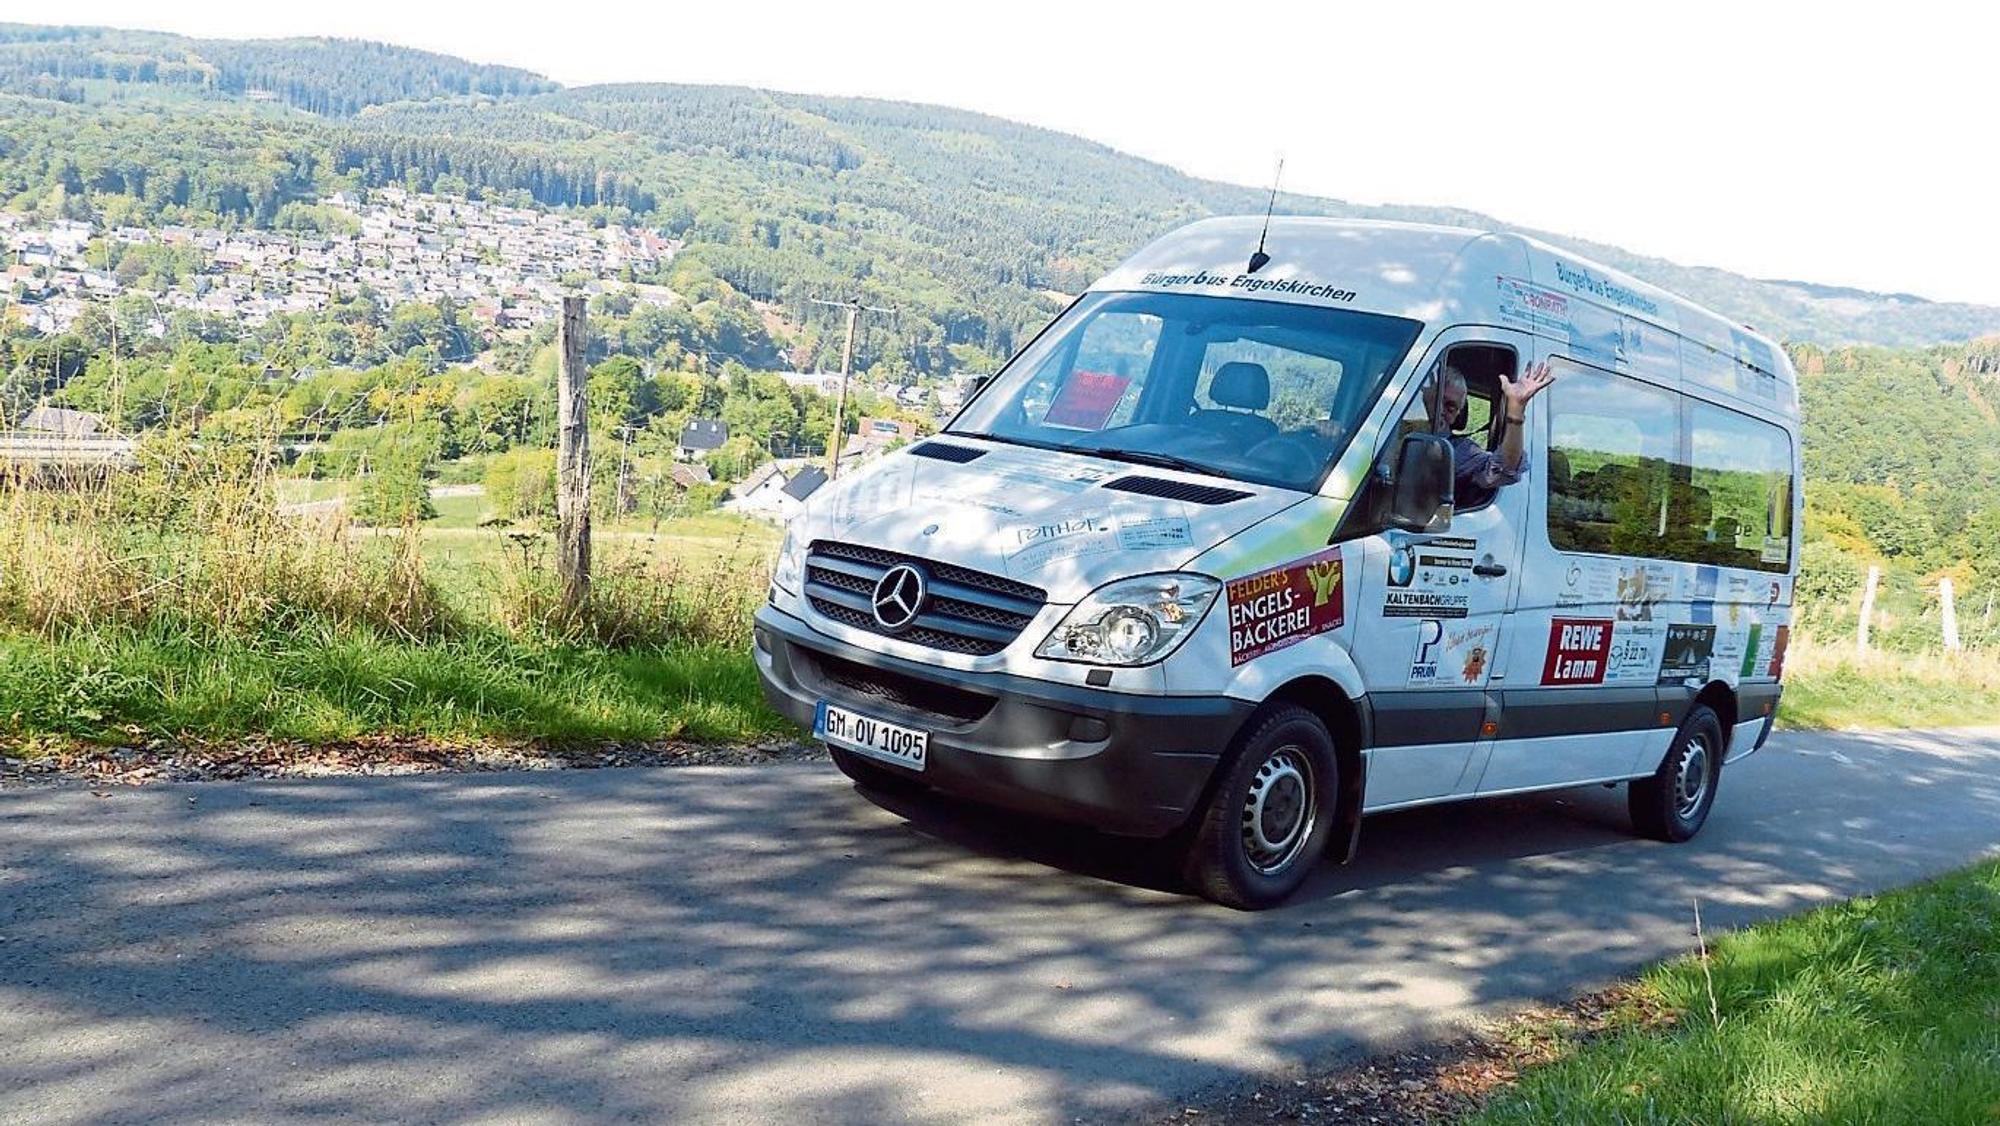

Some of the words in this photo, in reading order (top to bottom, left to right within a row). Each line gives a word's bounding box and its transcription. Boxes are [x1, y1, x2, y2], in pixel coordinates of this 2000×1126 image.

[1230, 274, 1357, 302] Engelskirchen
[1229, 568, 1289, 600] FELDER'S
[1230, 587, 1301, 627] ENGELS-
[1232, 606, 1310, 653] BÄCKEREI
[1560, 625, 1604, 651] REWE
[1554, 654, 1598, 679] Lamm
[826, 709, 846, 737] GM
[856, 719, 876, 746] OV
[880, 727, 923, 760] 1095
